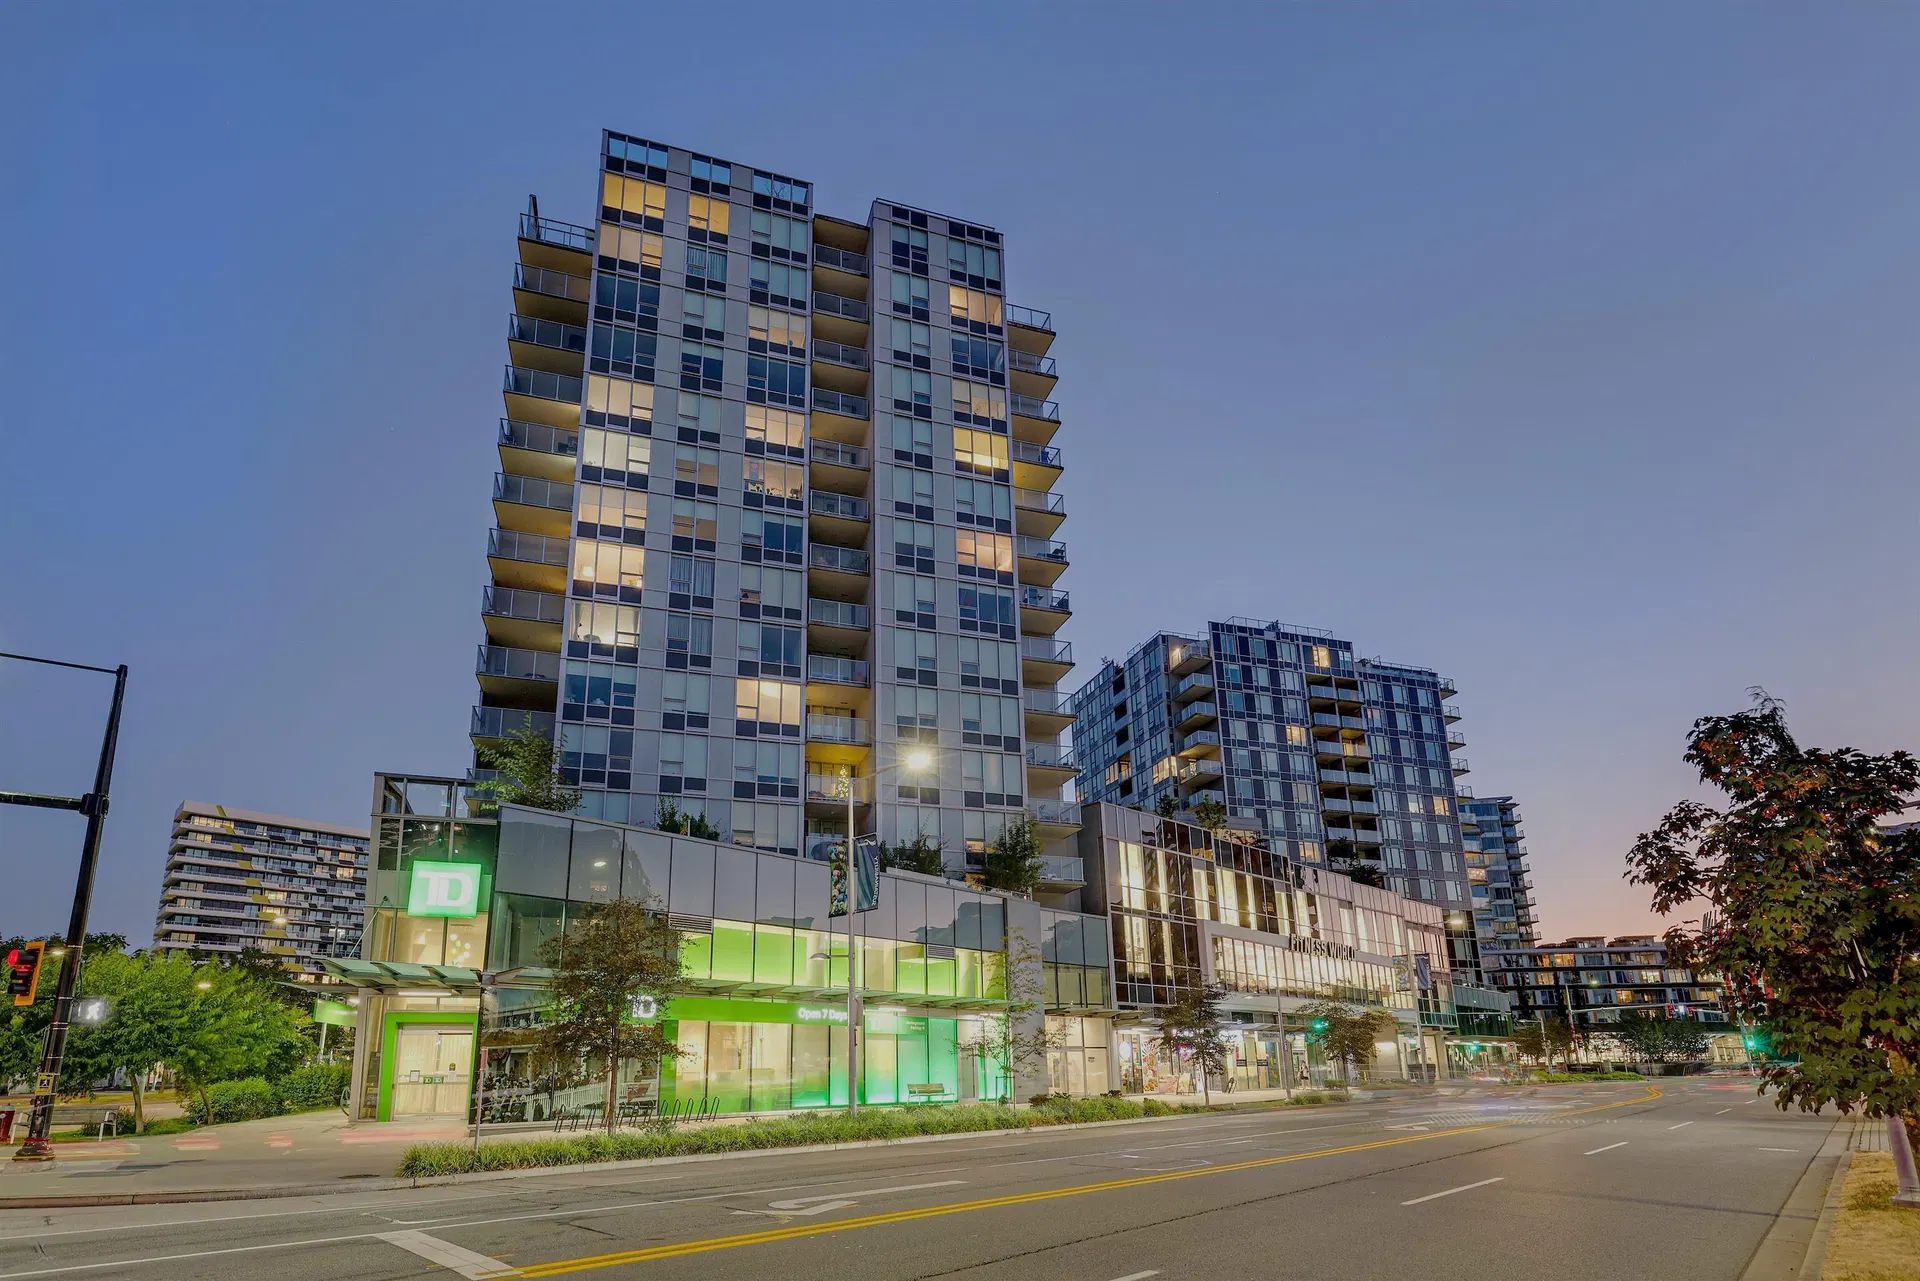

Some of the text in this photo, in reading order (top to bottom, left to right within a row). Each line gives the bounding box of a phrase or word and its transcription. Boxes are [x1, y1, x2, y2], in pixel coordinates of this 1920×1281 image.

[417, 871, 473, 907] TD
[1290, 933, 1356, 961] FITNESS WORLD
[627, 994, 657, 1018] TD
[798, 1008, 848, 1022] Open 7 Days
